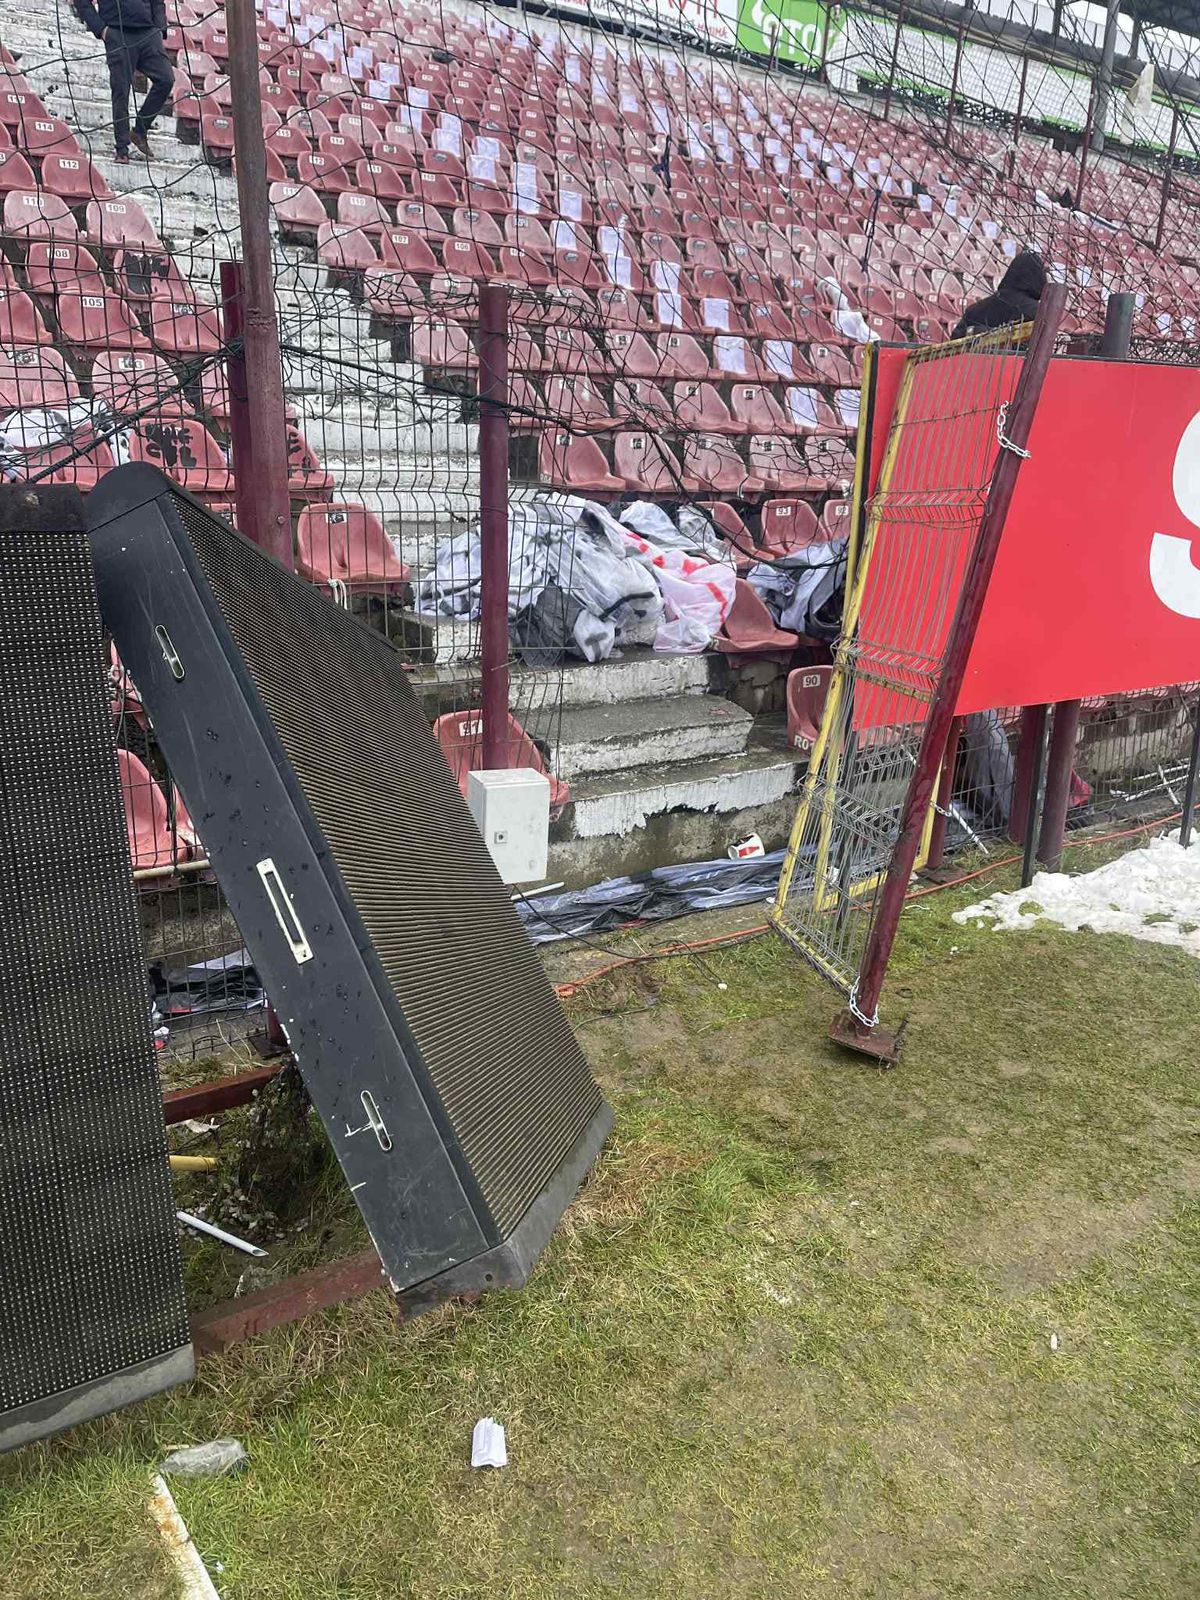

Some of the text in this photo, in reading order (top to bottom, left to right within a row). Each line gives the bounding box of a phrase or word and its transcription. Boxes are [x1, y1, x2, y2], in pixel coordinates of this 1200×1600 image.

[37, 122, 53, 131] 114
[61, 160, 77, 168] 112
[82, 297, 103, 307] 105
[805, 675, 818, 686] 90
